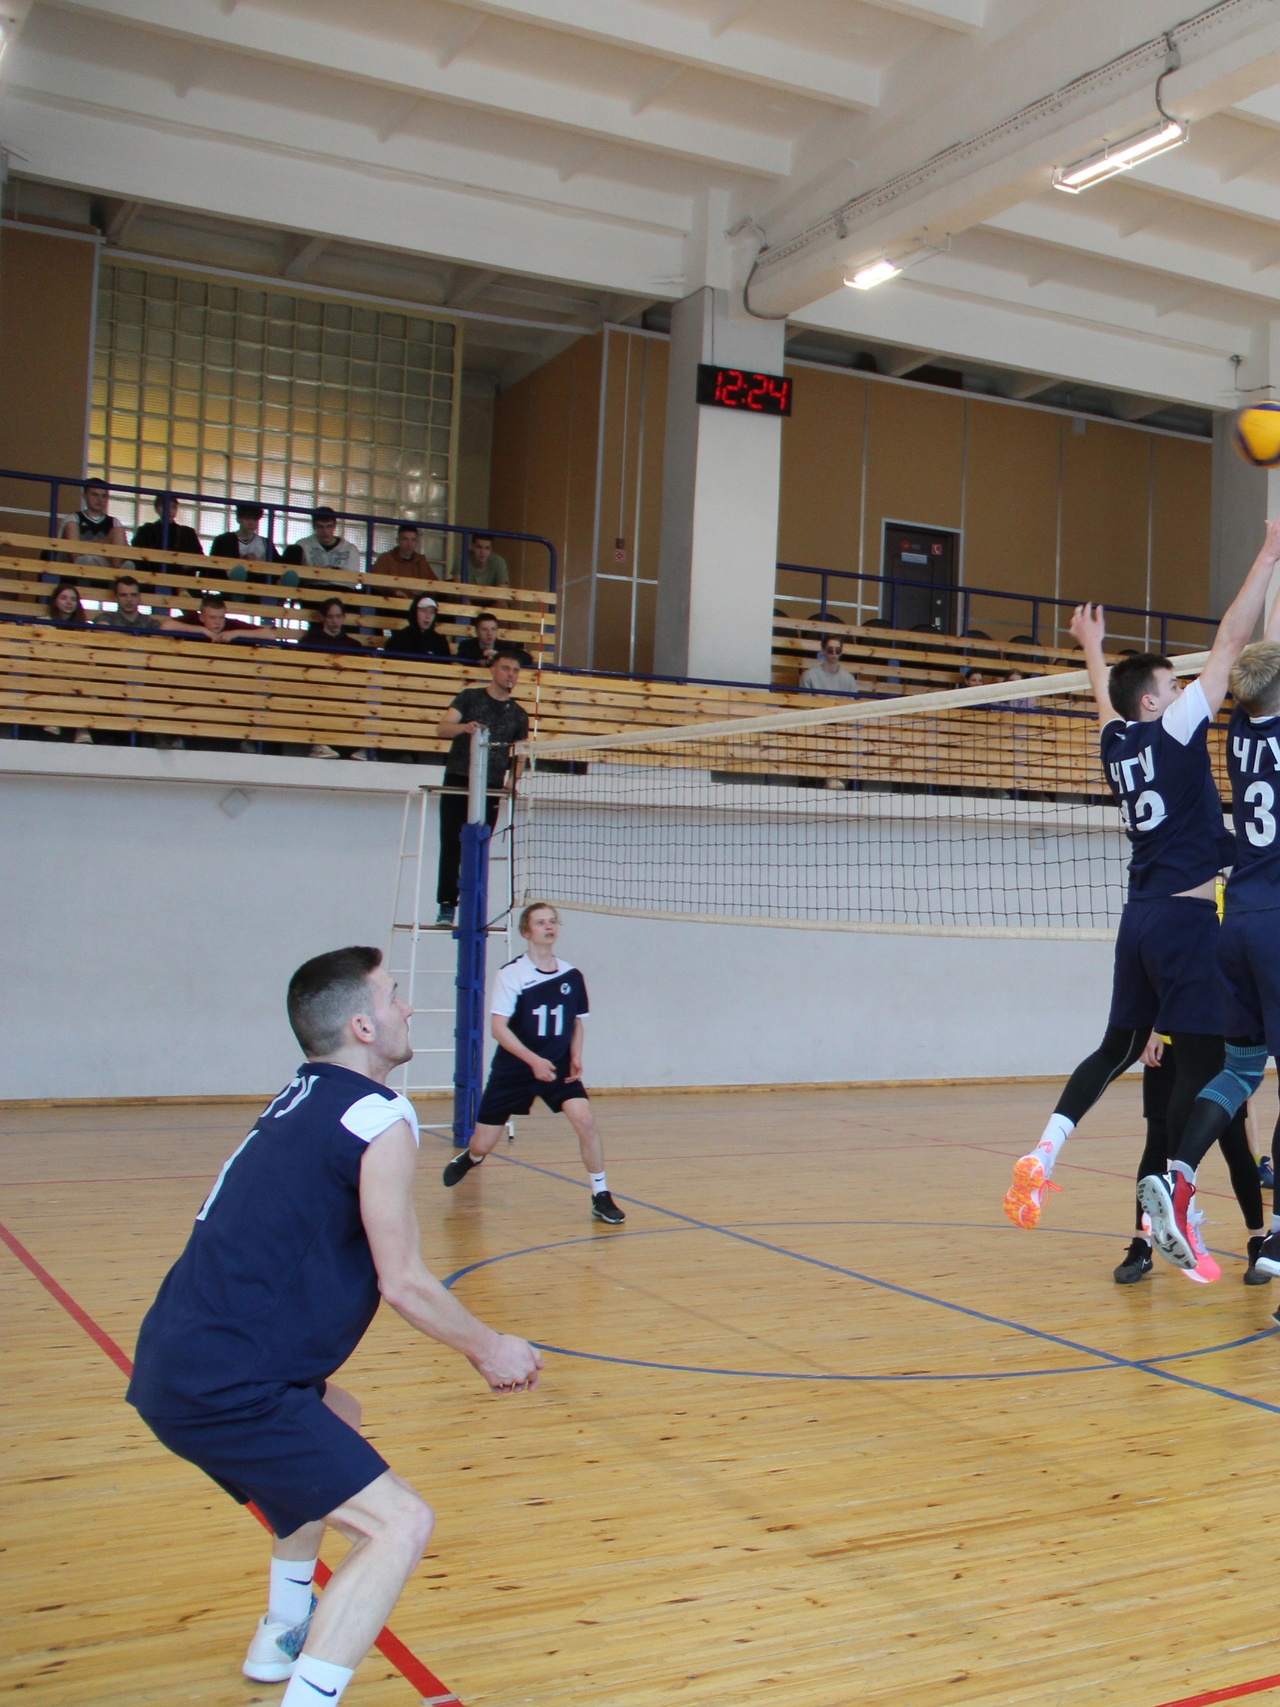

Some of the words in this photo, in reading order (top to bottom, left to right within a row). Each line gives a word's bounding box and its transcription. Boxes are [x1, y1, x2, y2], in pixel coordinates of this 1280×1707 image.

[714, 370, 789, 410] 12:24
[1110, 745, 1155, 795] ЧГУ
[1244, 780, 1277, 848] 3
[532, 1004, 564, 1037] 11
